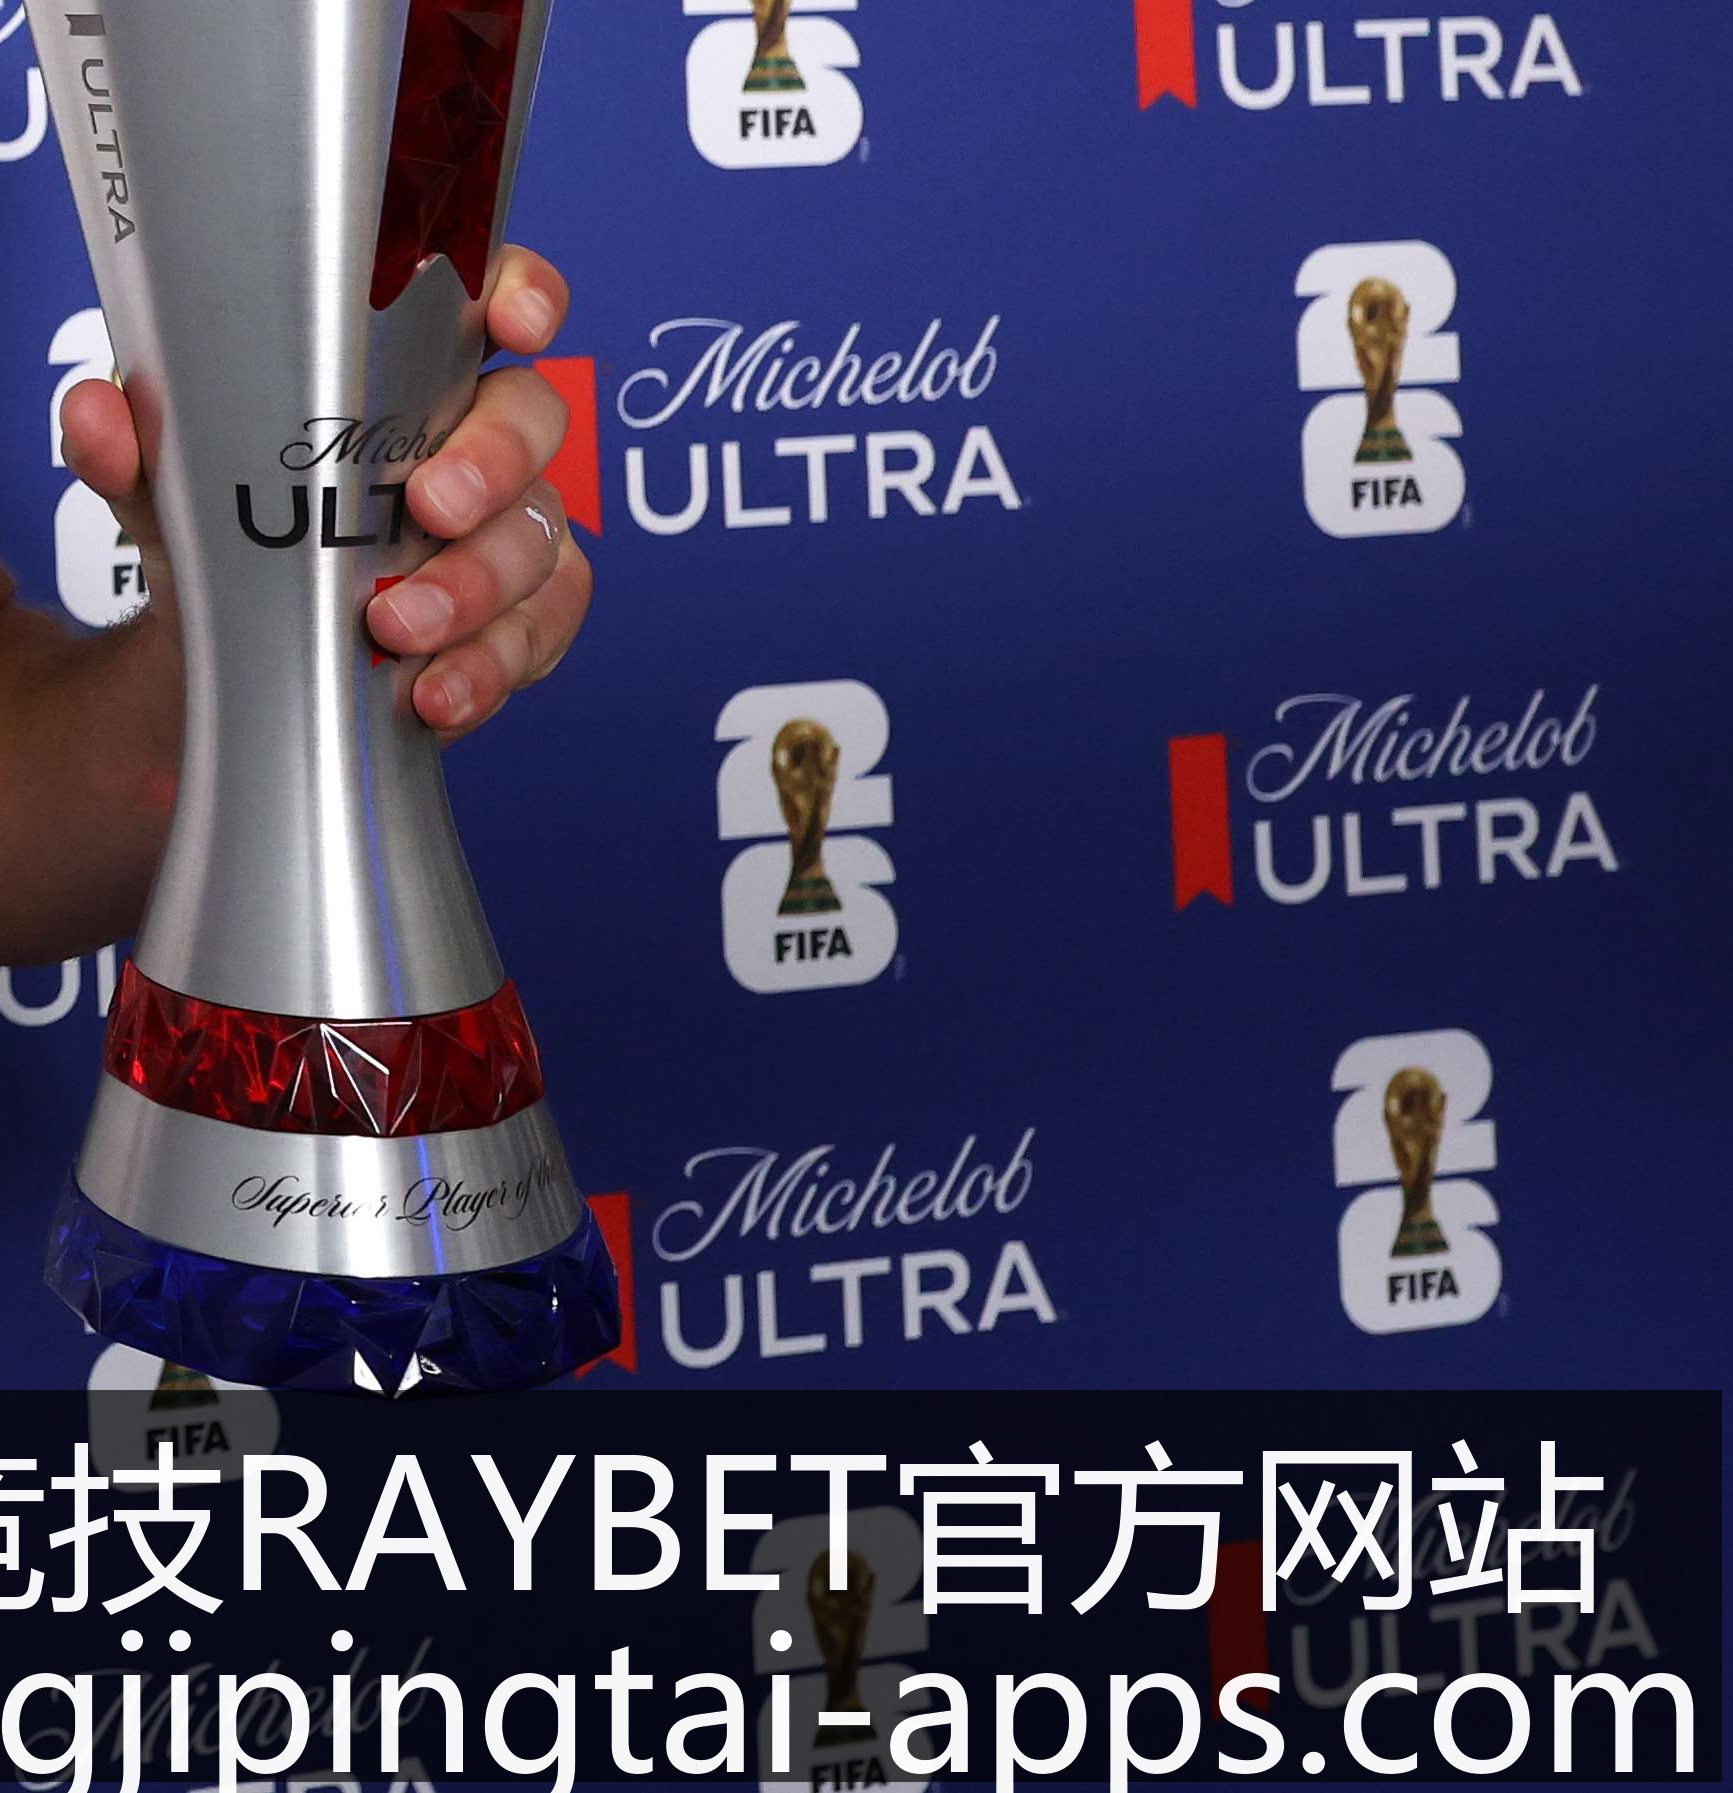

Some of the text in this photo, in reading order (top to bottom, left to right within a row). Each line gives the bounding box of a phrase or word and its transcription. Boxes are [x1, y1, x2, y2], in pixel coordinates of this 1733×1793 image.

[1218, 15, 1581, 109] ULTRA
[81, 59, 135, 244] ULTRA
[741, 108, 815, 137] FIFA
[618, 315, 1000, 429] Michelob
[235, 483, 410, 549] ULT
[625, 426, 1022, 535] ULTRA
[1352, 478, 1421, 508] FIFA
[1248, 685, 1597, 802] Michelob
[1254, 791, 1618, 904] ULTRA
[776, 928, 851, 962] FIFA
[232, 1176, 390, 1228] Superir
[396, 1176, 508, 1231] Player
[653, 1128, 1034, 1261] Michelob
[661, 1242, 1057, 1368] ULTRA
[1389, 1270, 1458, 1302] FIFA
[1292, 1577, 1659, 1709] ULTRA
